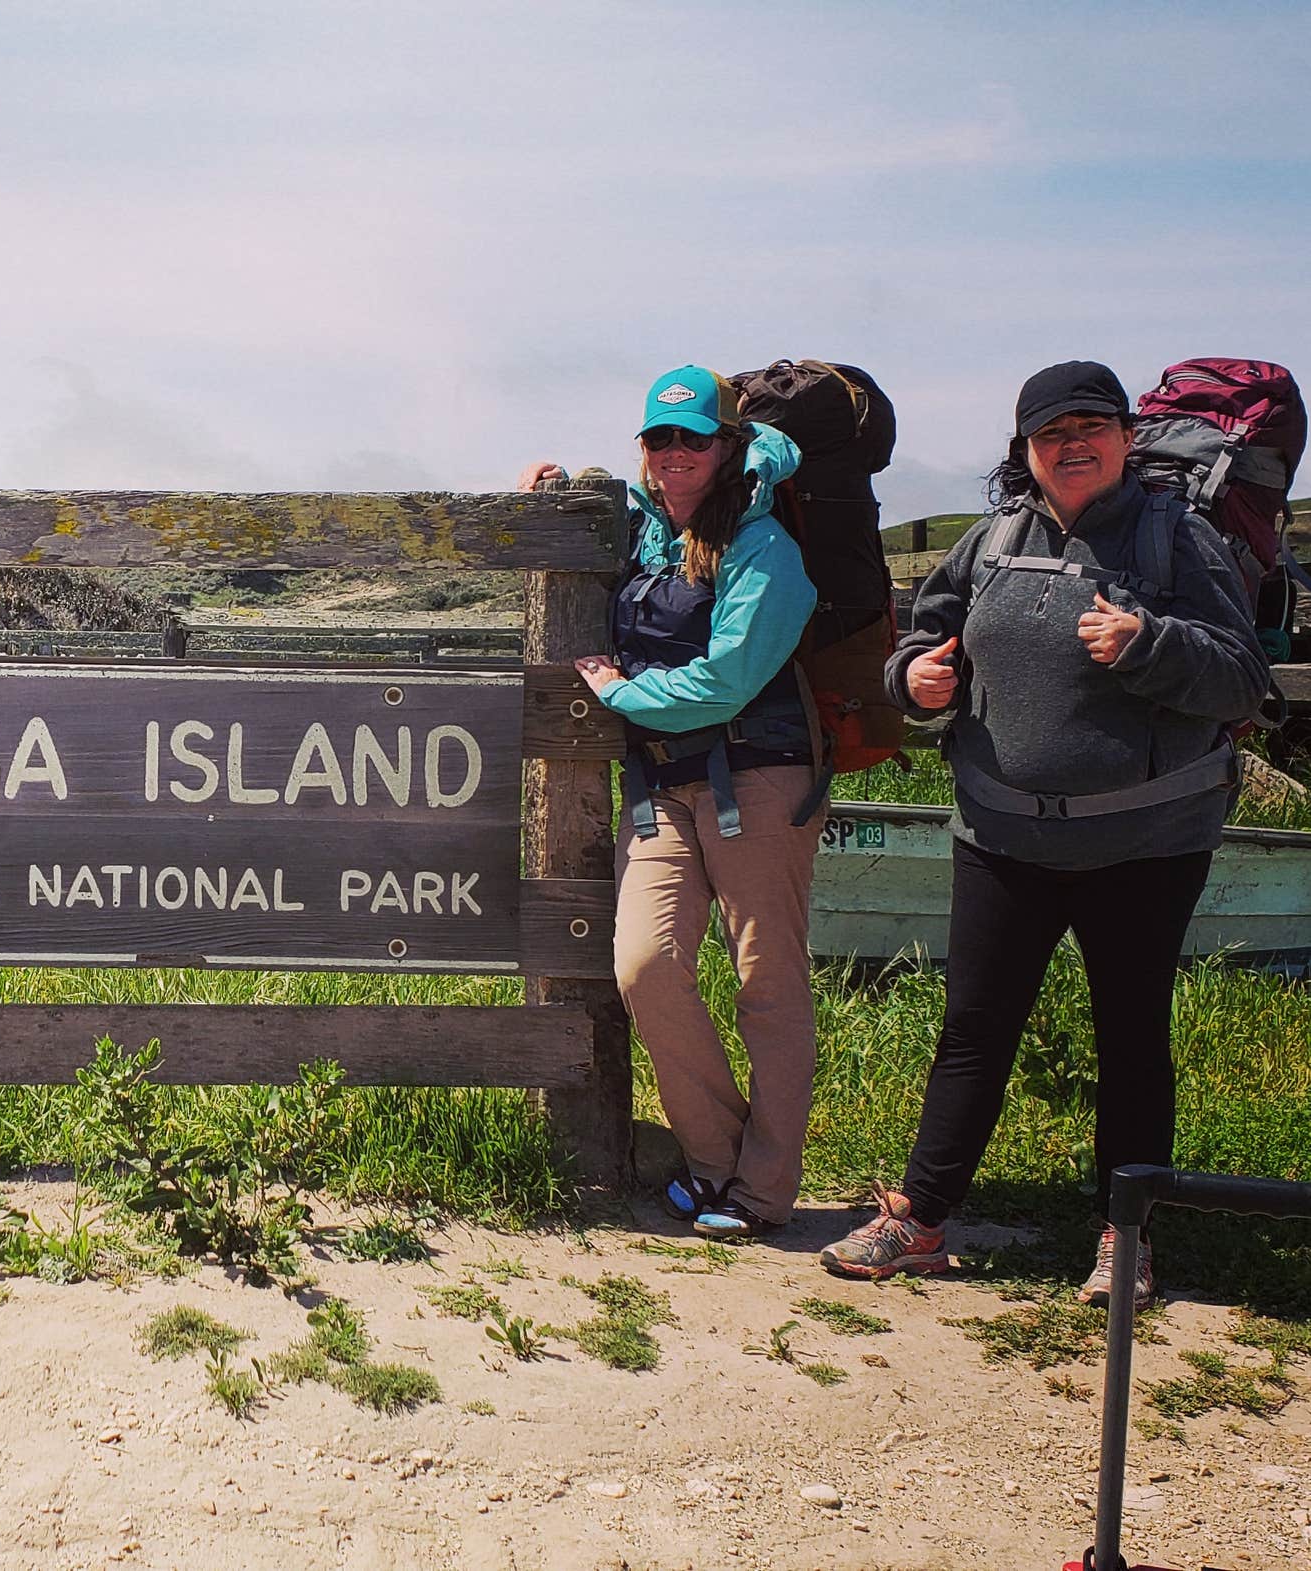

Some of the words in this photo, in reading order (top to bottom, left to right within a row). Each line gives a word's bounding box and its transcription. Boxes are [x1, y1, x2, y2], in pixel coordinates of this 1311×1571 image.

[144, 719, 482, 808] ISLAND
[866, 827, 882, 842] 03
[28, 864, 305, 912] NATIONAL
[340, 869, 482, 916] PARK
